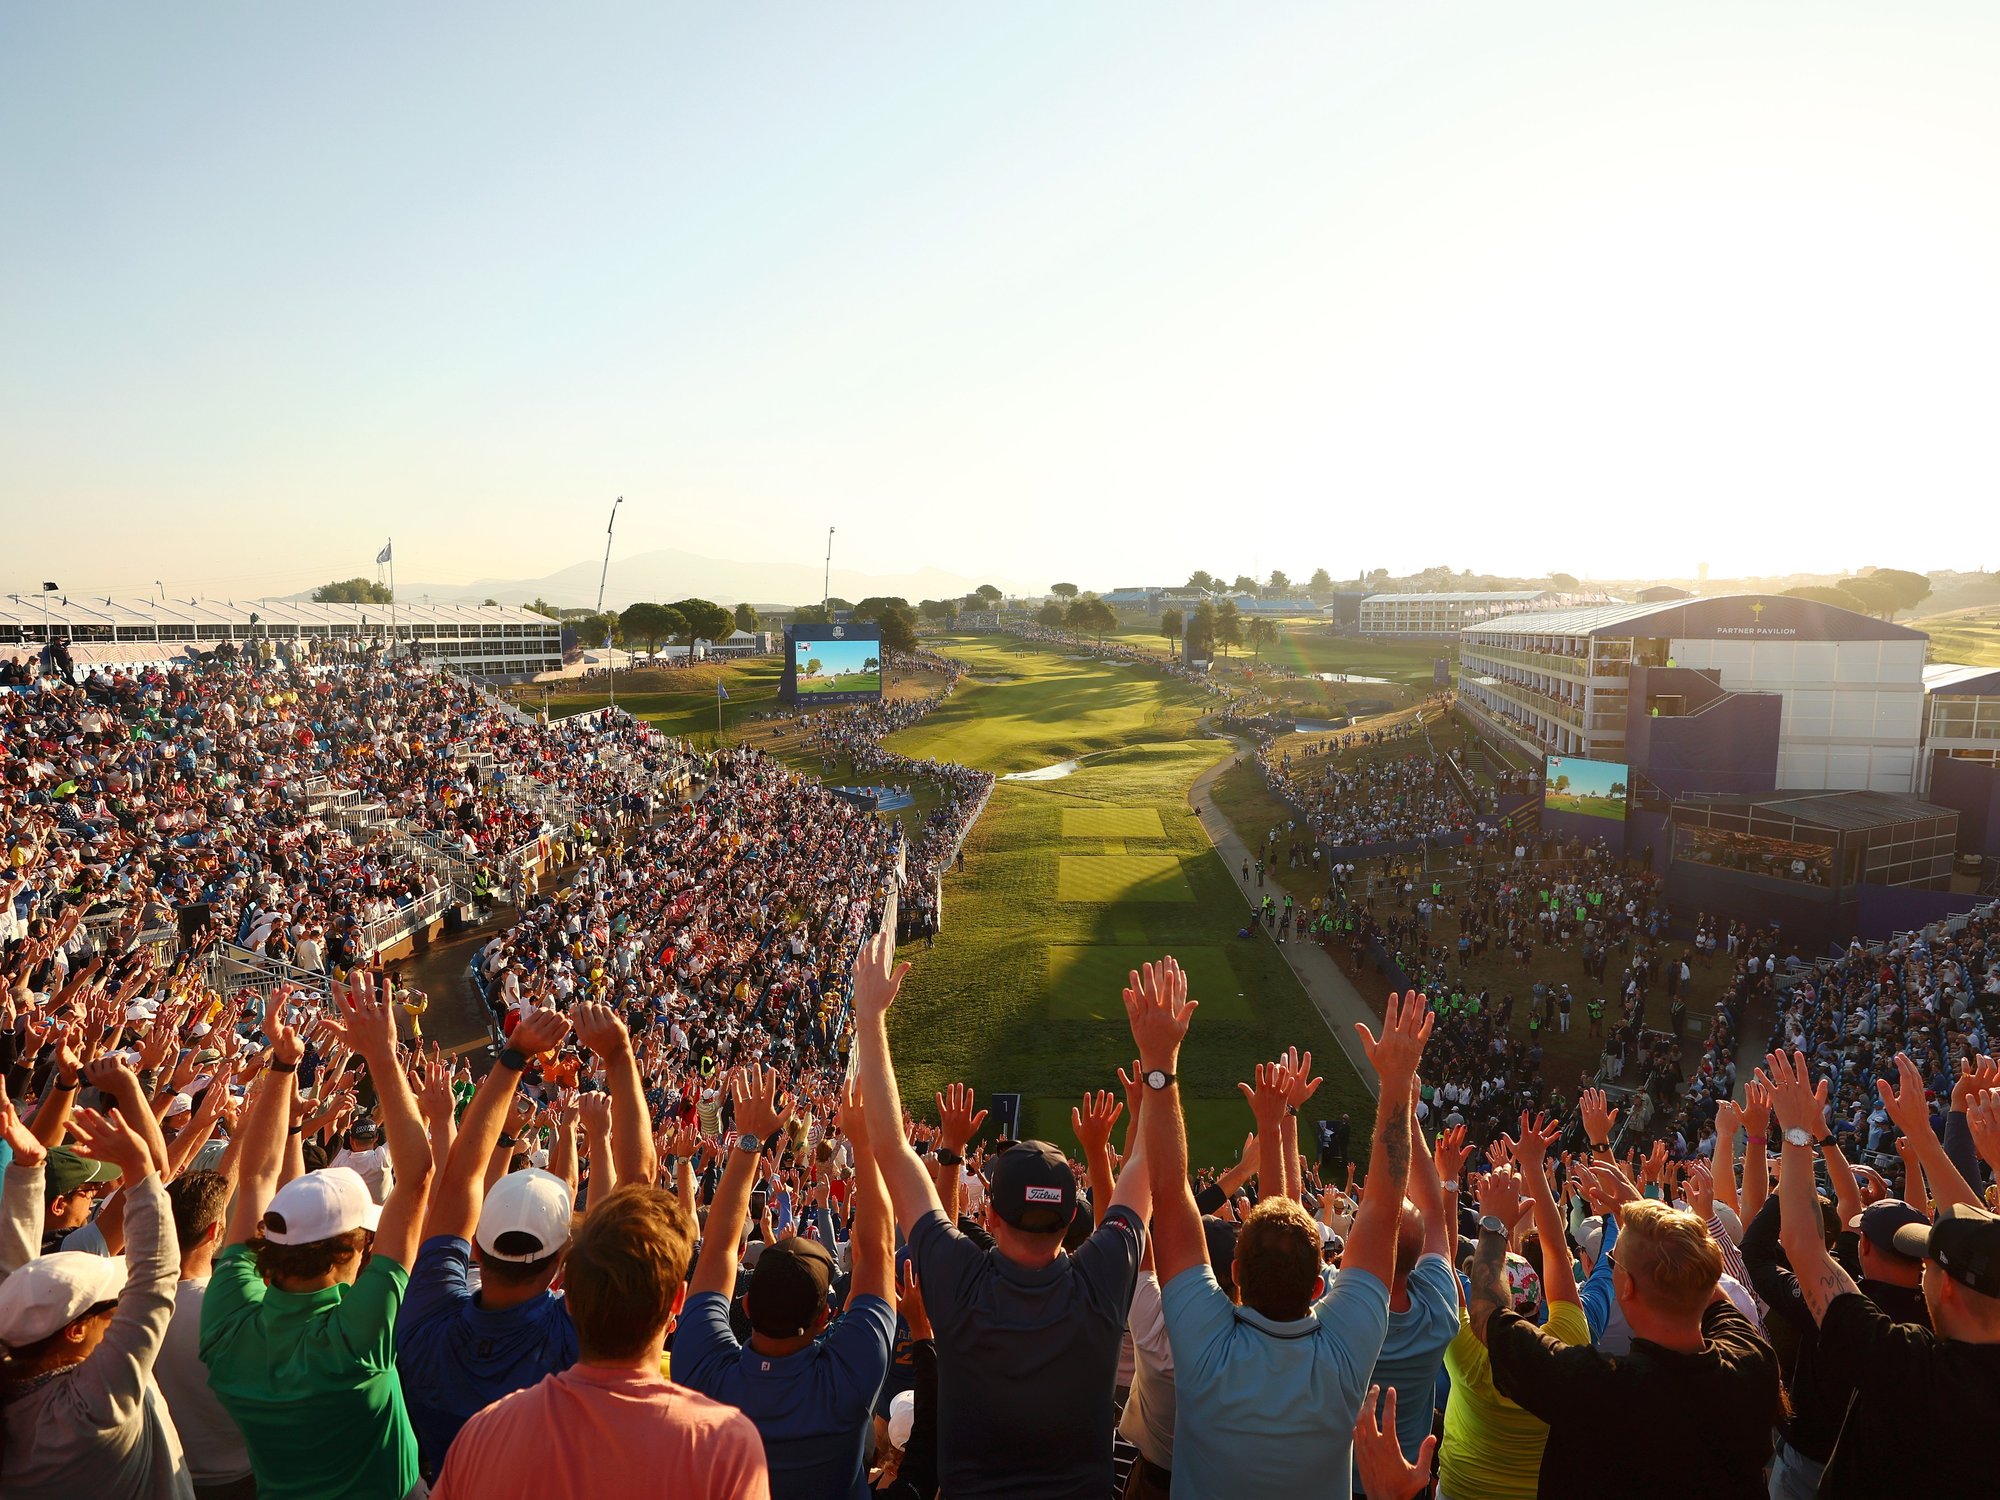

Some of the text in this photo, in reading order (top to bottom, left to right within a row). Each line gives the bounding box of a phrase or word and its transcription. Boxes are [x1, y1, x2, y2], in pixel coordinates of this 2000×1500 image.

[1002, 1100, 1008, 1113] 1
[1028, 1189, 1060, 1201] Titleist
[761, 1361, 771, 1371] FJ
